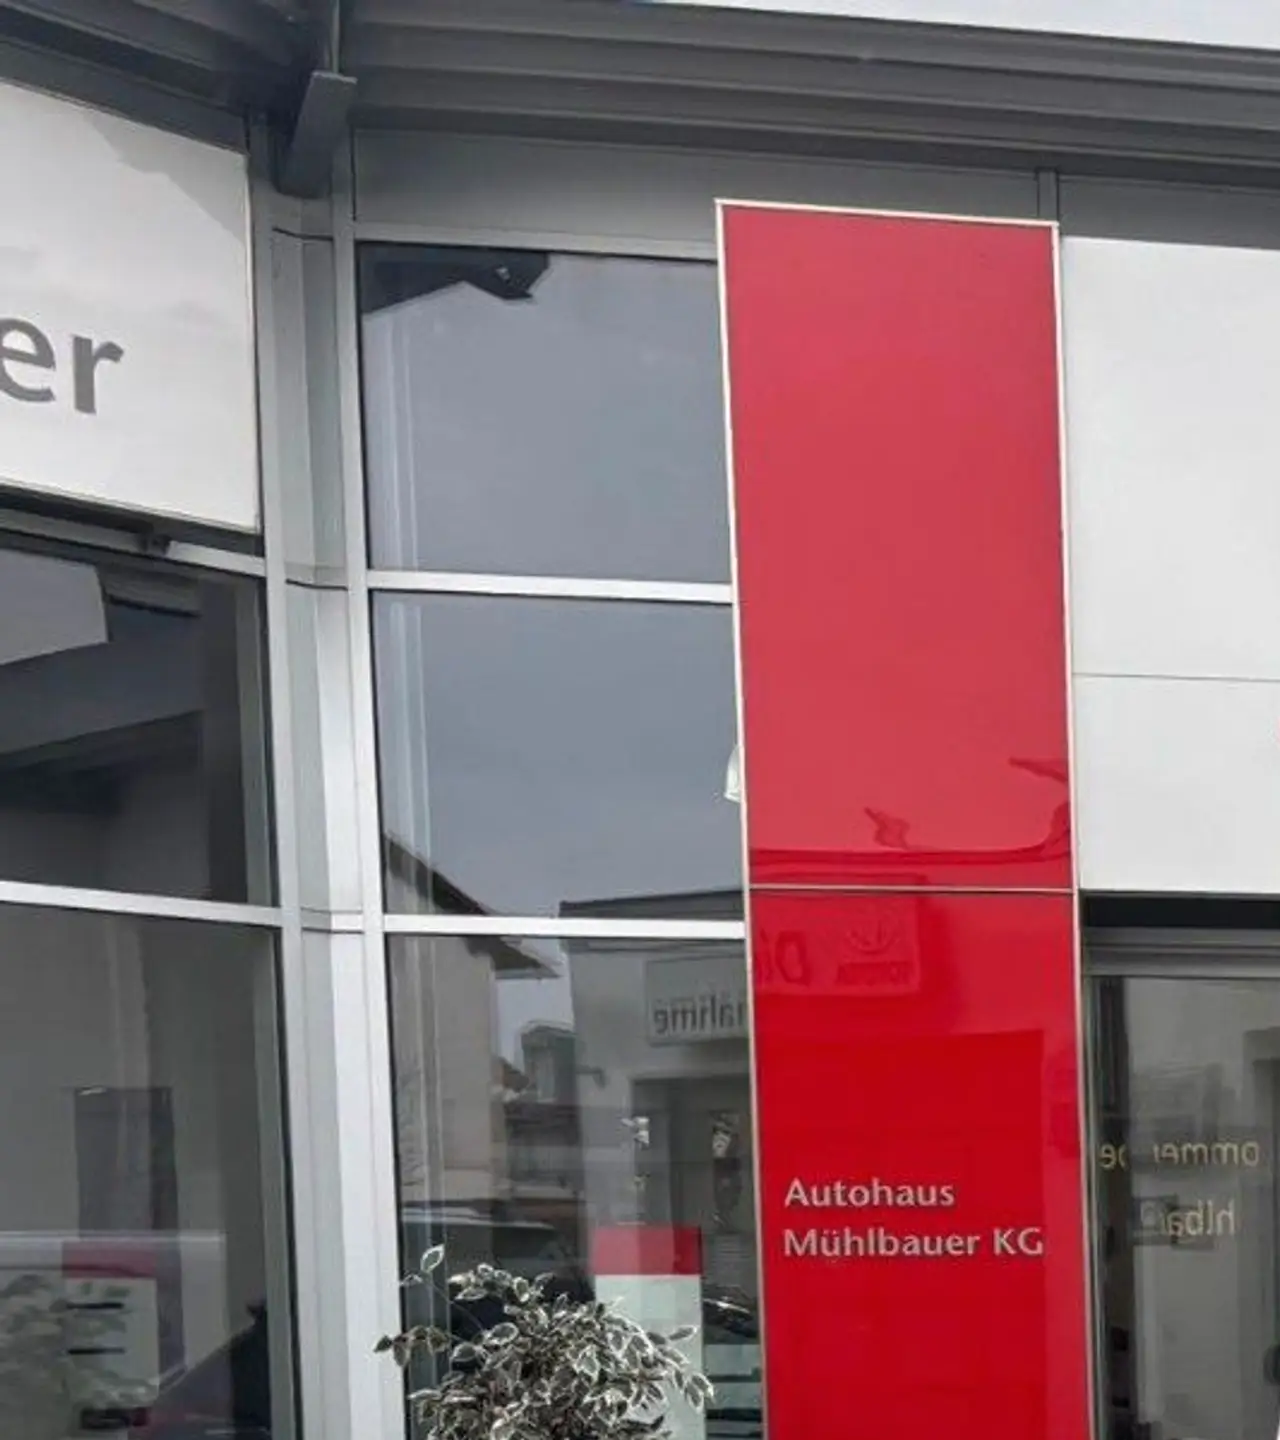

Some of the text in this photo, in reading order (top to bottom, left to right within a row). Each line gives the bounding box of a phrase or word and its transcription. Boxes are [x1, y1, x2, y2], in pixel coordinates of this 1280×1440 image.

[785, 1177, 955, 1207] Autohaus
[784, 1226, 1044, 1257] Mühlbauer KG
